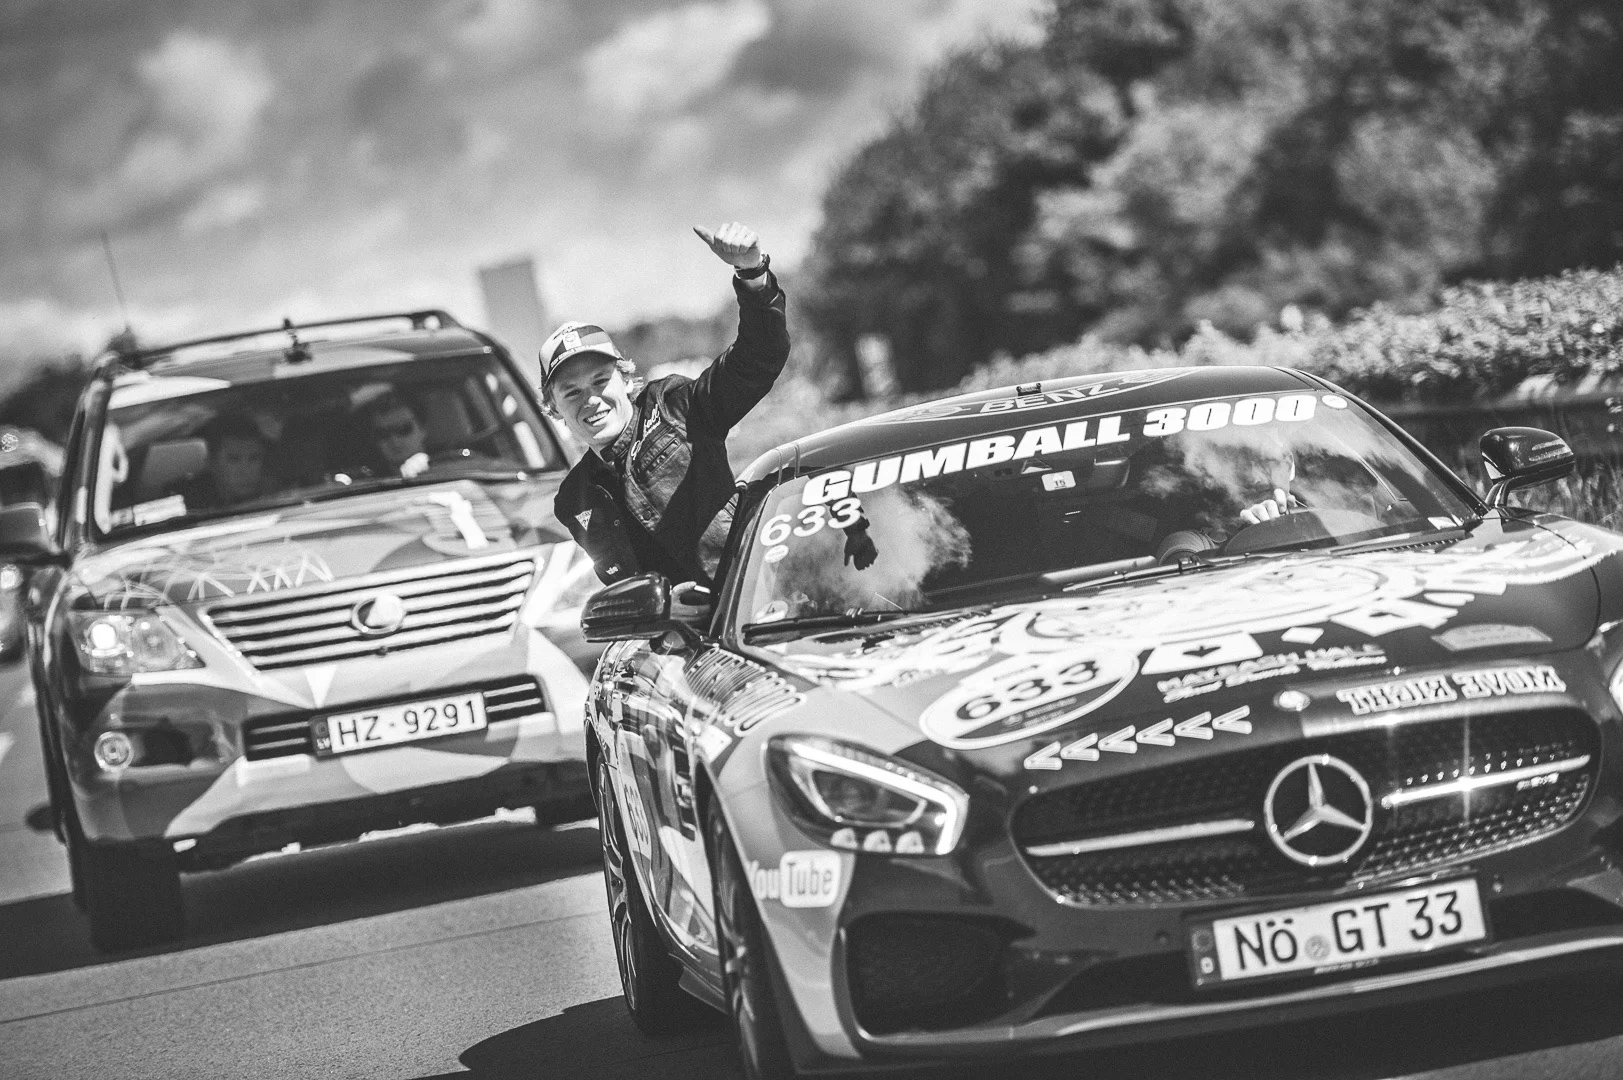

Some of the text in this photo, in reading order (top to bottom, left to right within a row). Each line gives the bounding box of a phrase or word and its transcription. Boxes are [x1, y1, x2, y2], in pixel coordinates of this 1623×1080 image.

[979, 384, 1121, 414] BENZ
[802, 395, 1317, 506] GUMBALL 3000
[759, 497, 862, 546] 633
[955, 660, 1100, 720] 633
[747, 858, 835, 900] YouTube
[1233, 890, 1463, 970] NÖ GT 33
